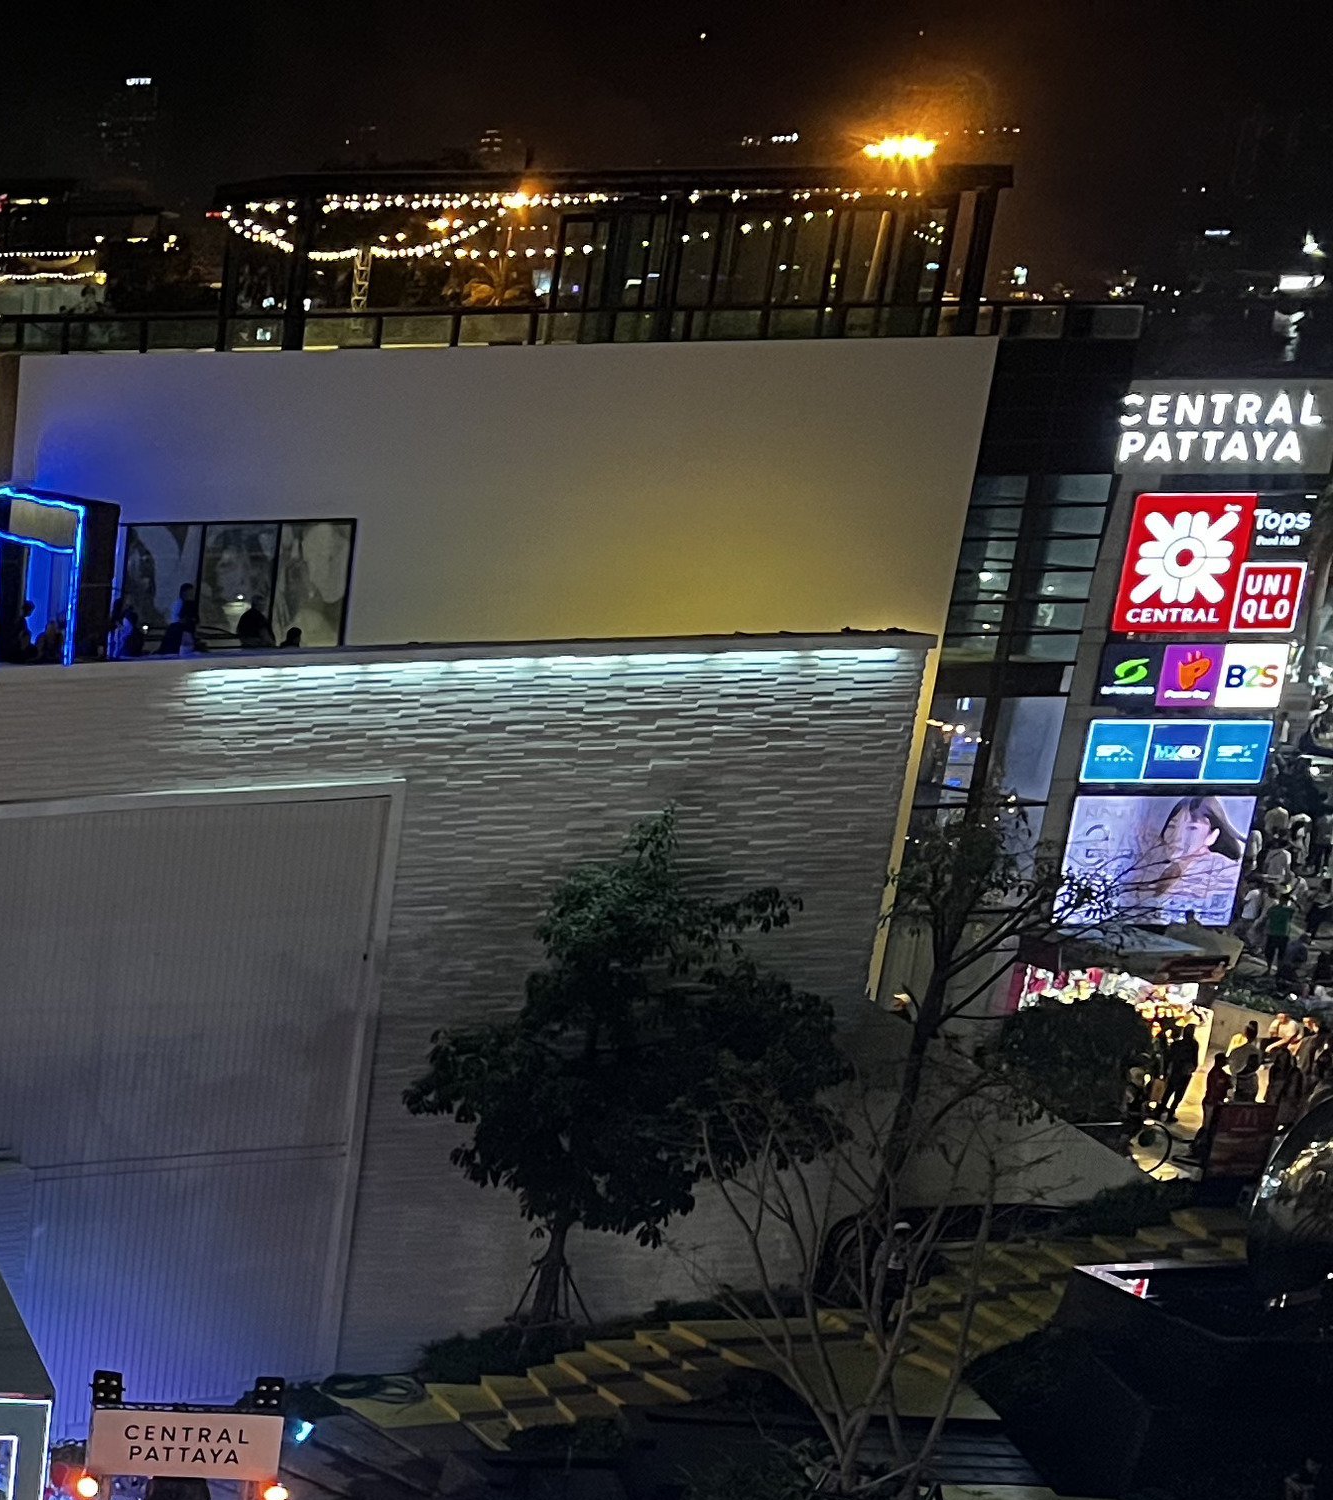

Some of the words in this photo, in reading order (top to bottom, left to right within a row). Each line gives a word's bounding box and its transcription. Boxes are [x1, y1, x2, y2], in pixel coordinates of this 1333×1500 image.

[1119, 392, 1323, 426] CENTRAL
[1118, 430, 1302, 463] PATTAYA
[1253, 508, 1312, 535] Tops
[1245, 574, 1292, 596] UNI
[1125, 607, 1220, 624] CENTRAL
[1241, 598, 1291, 624] QLO
[1224, 664, 1279, 688] B2S
[124, 1425, 250, 1445] CENTRAL
[129, 1445, 240, 1465] PATTAYA
